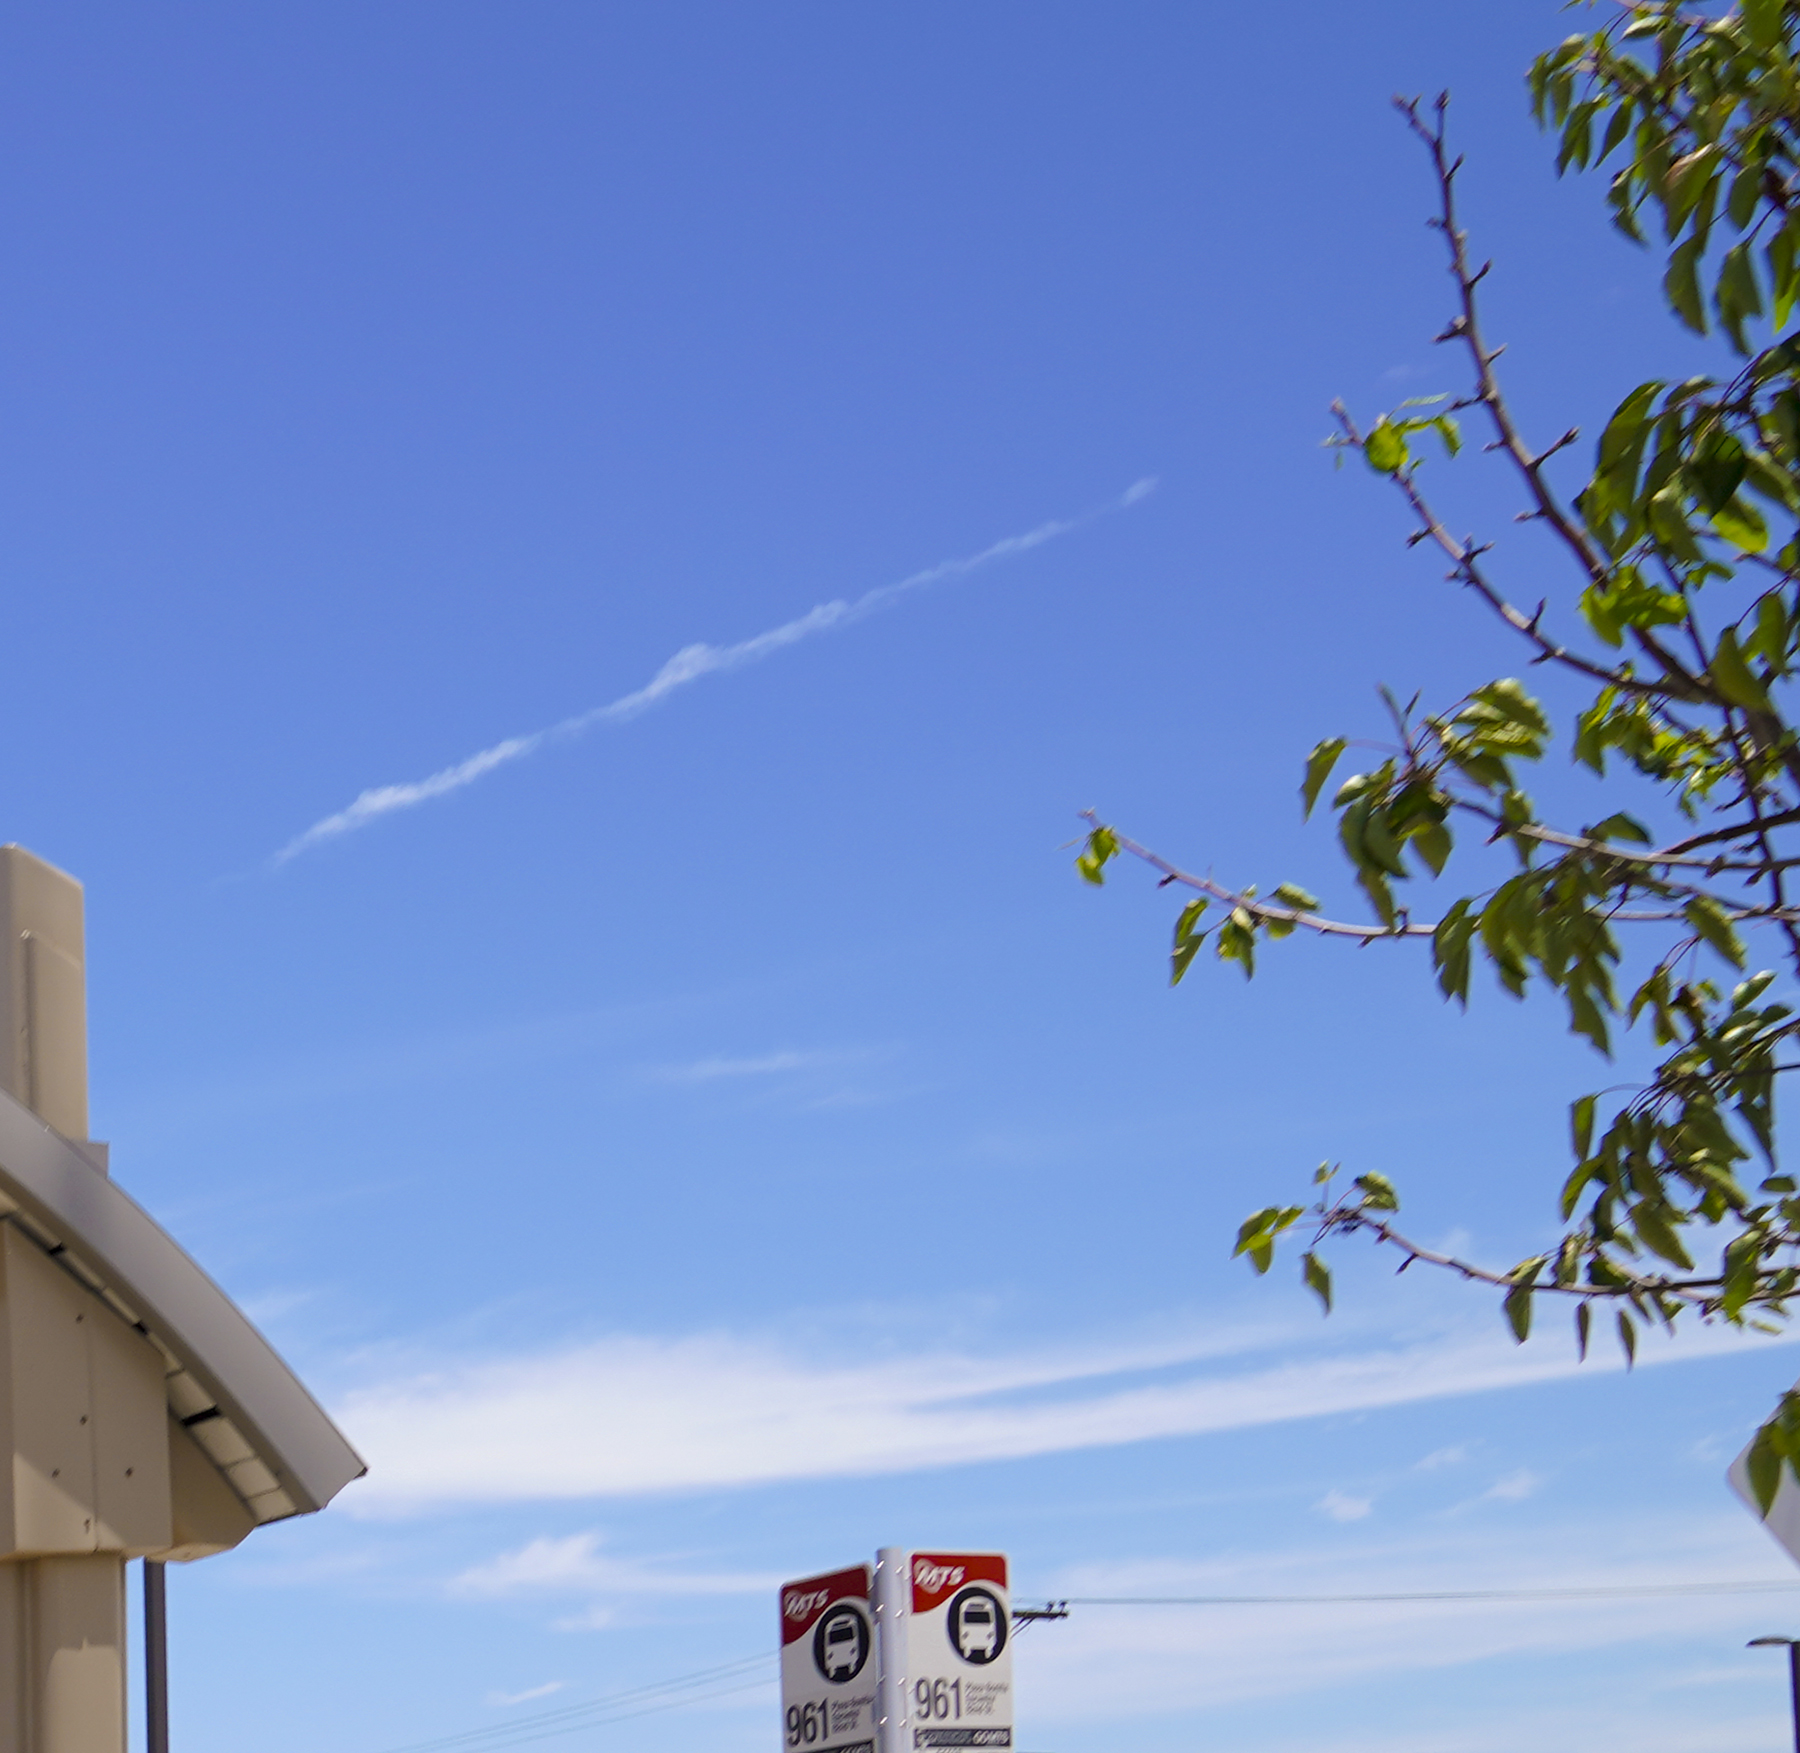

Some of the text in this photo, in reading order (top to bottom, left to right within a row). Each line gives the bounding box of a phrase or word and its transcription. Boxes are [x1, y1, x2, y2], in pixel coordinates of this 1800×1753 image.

[914, 1564, 966, 1587] MTS
[784, 1588, 830, 1617] MTS
[915, 1676, 962, 1719] 961
[787, 1697, 828, 1747] 961
